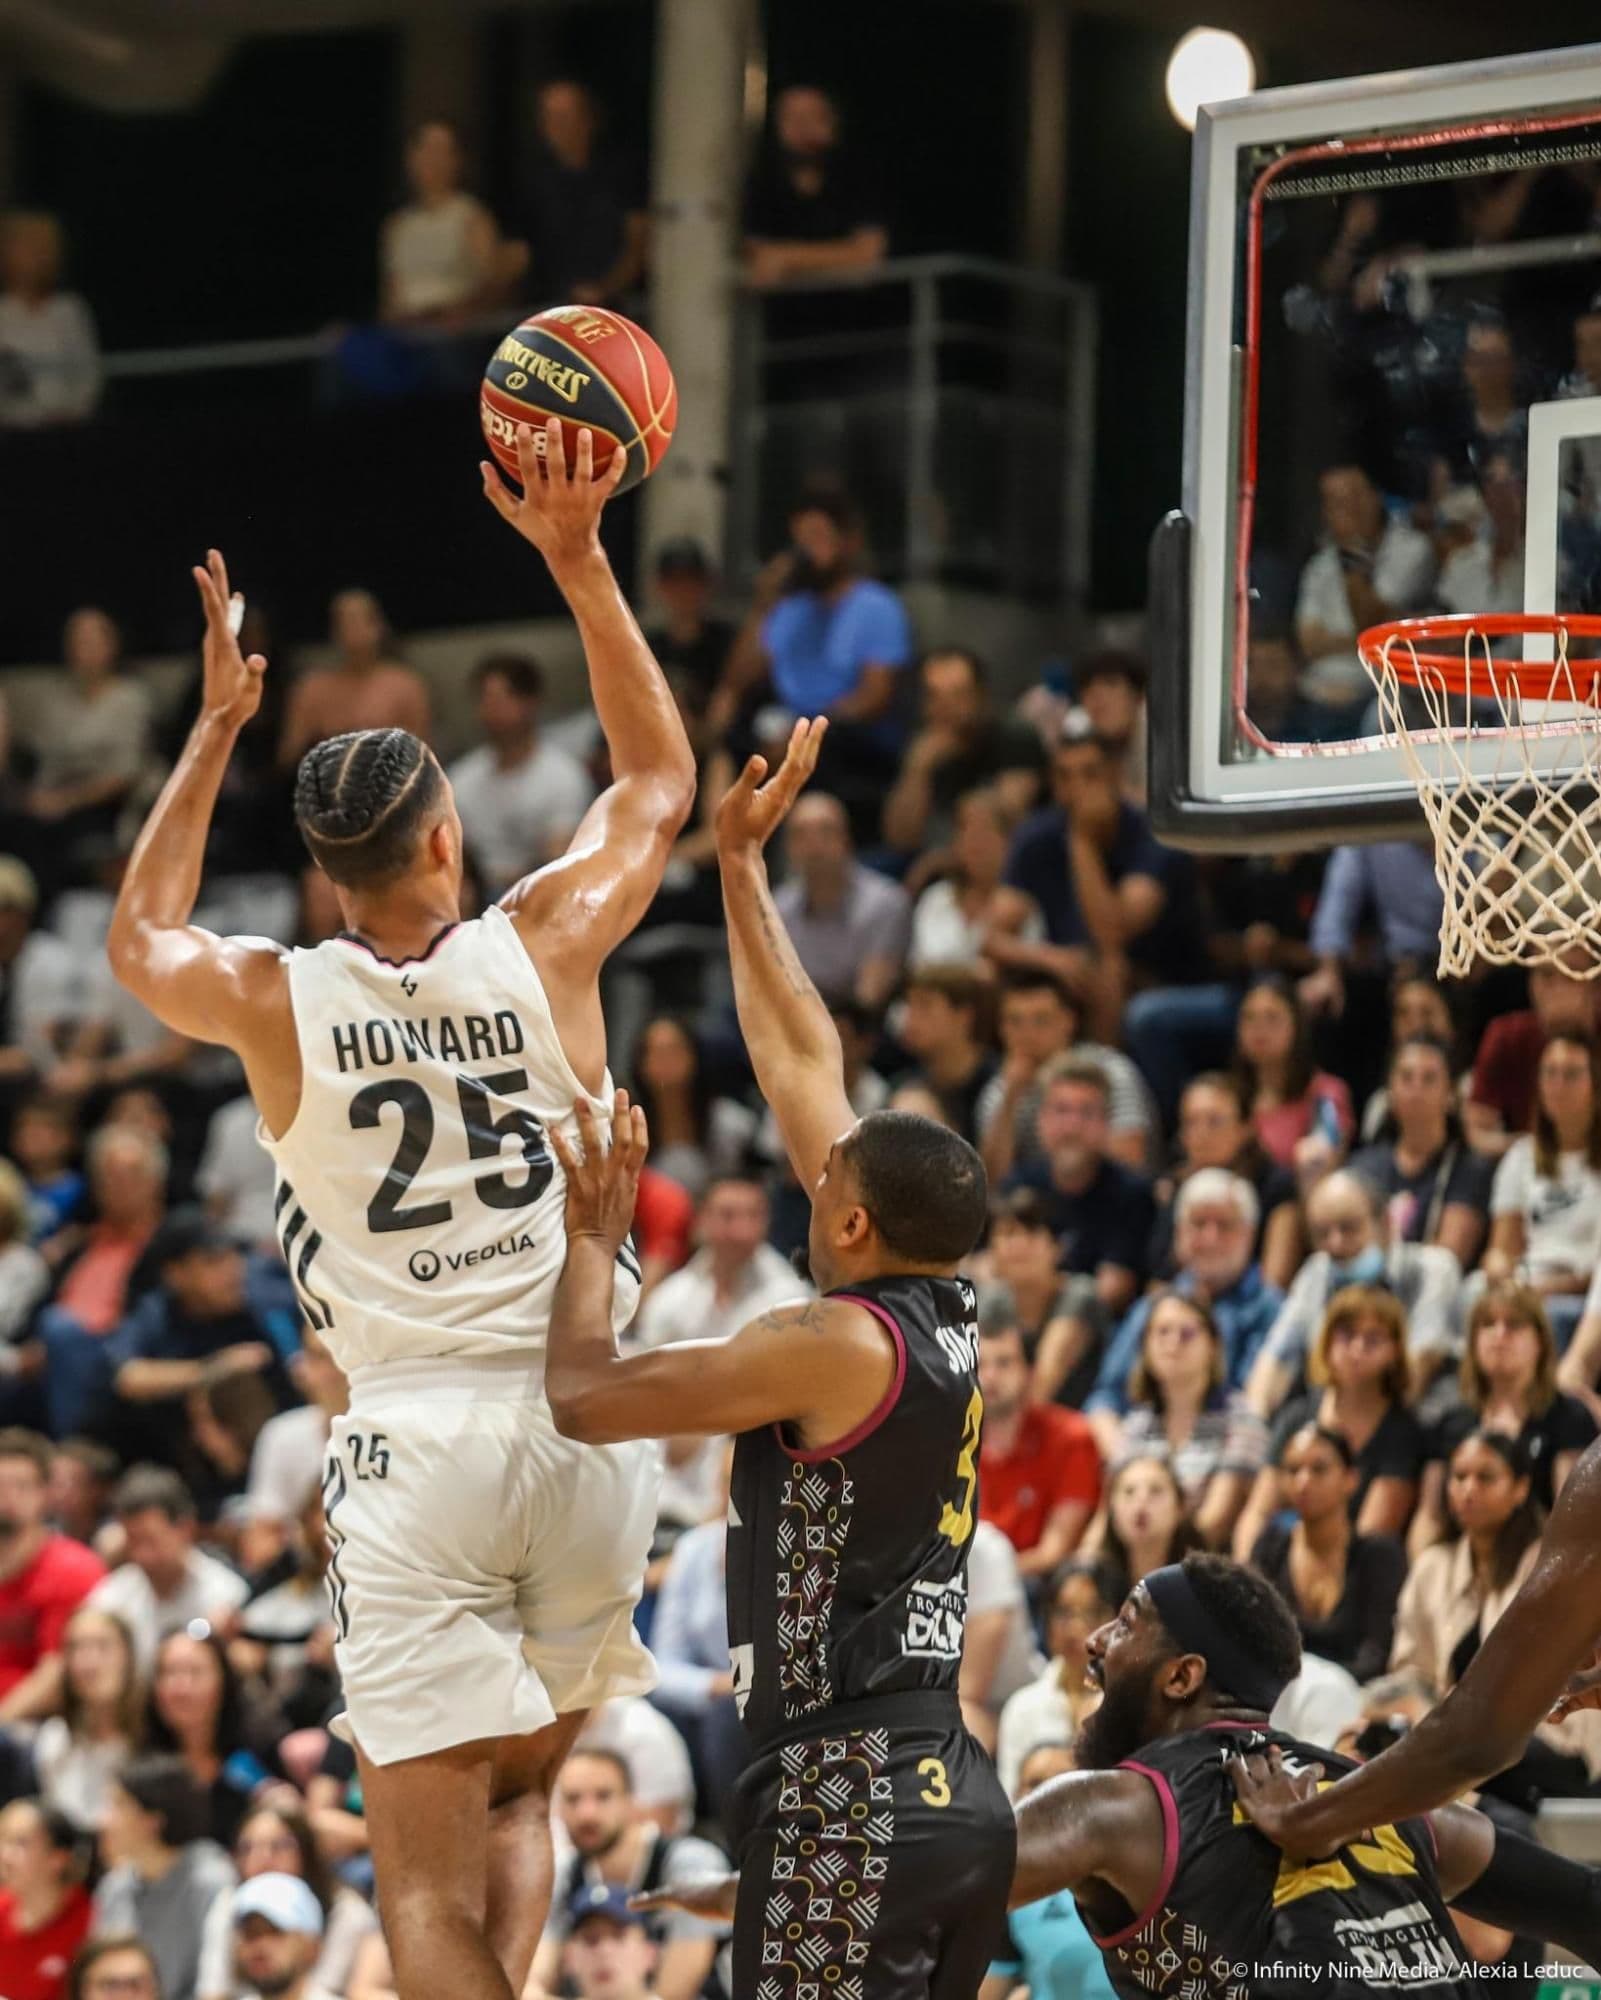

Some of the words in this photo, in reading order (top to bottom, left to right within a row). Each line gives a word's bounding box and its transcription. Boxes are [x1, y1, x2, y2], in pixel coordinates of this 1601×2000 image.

[498, 335, 590, 403] SPALDIN
[332, 1009, 524, 1073] HOWARD
[348, 1068, 555, 1233] 25
[445, 1233, 535, 1271] VEOLIA
[347, 1432, 391, 1480] 25
[938, 1385, 983, 1547] 3
[917, 1757, 951, 1808] 3
